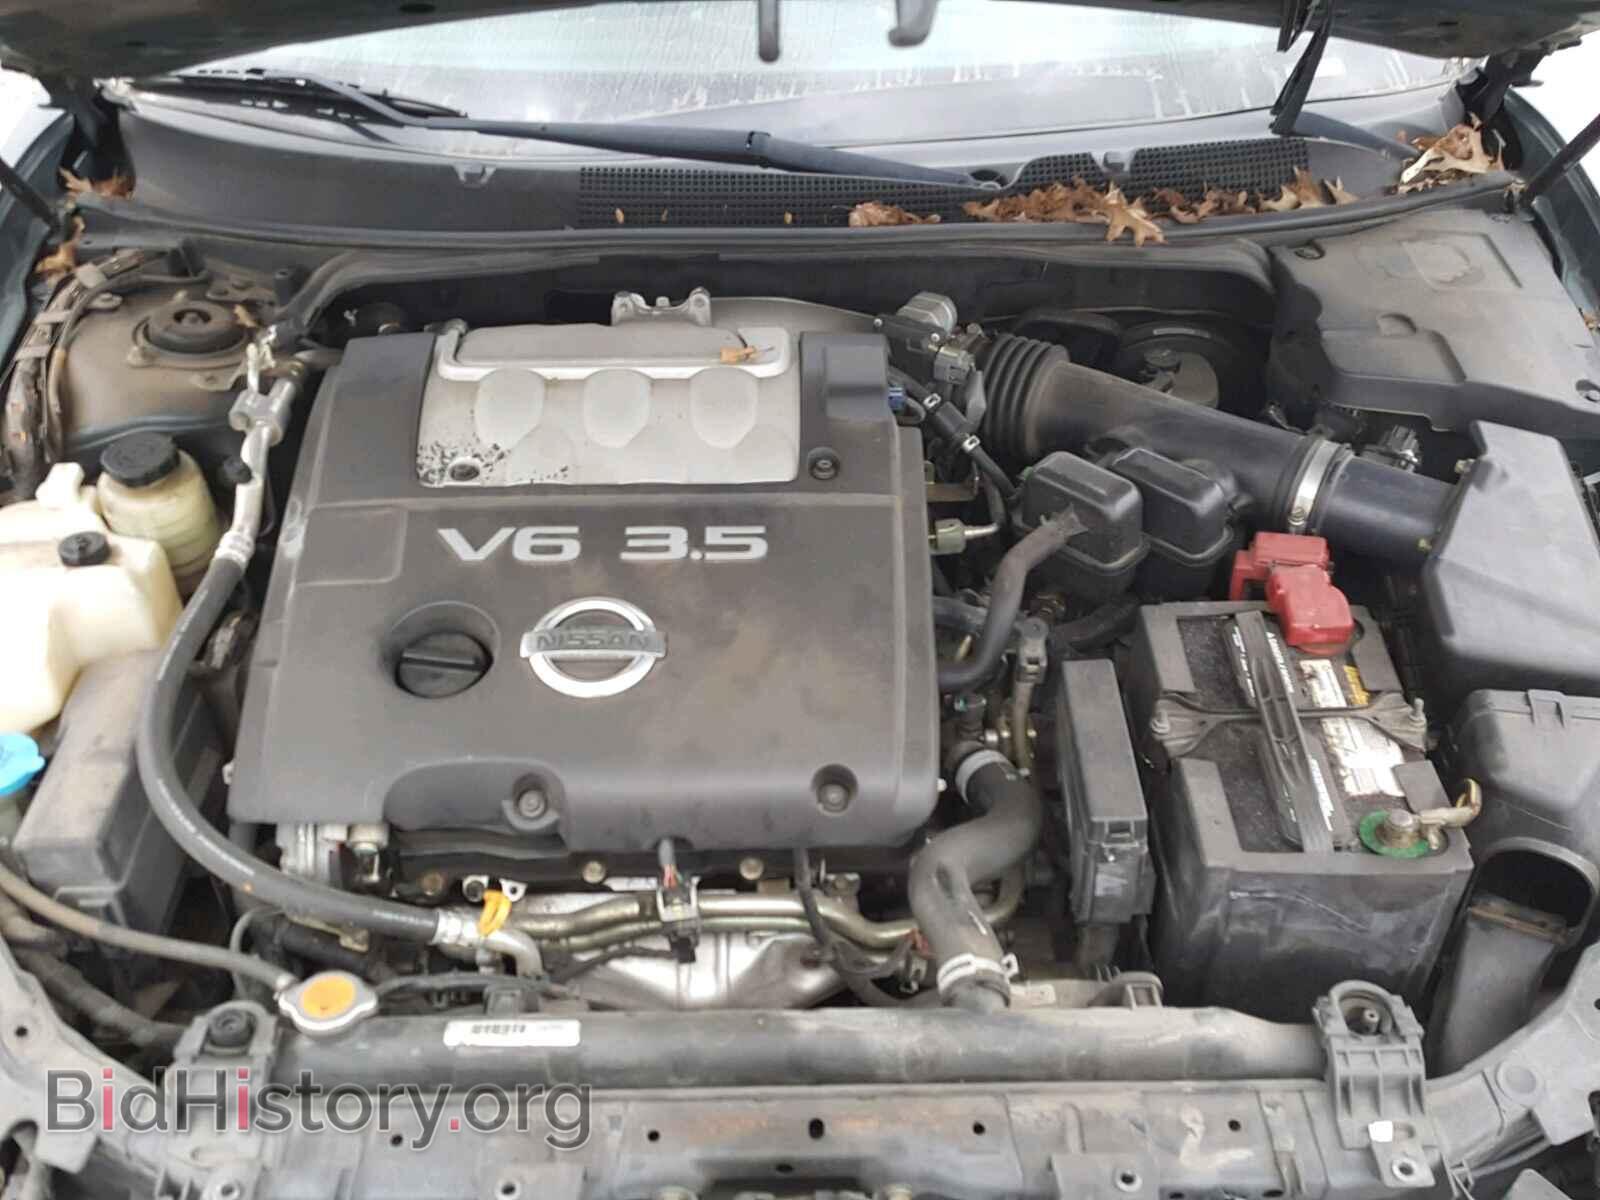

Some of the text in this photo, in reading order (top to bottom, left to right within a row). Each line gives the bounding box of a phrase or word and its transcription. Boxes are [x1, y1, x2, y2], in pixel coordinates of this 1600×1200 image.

[438, 525, 768, 561] V6 3.5
[536, 630, 650, 650] NISSAN
